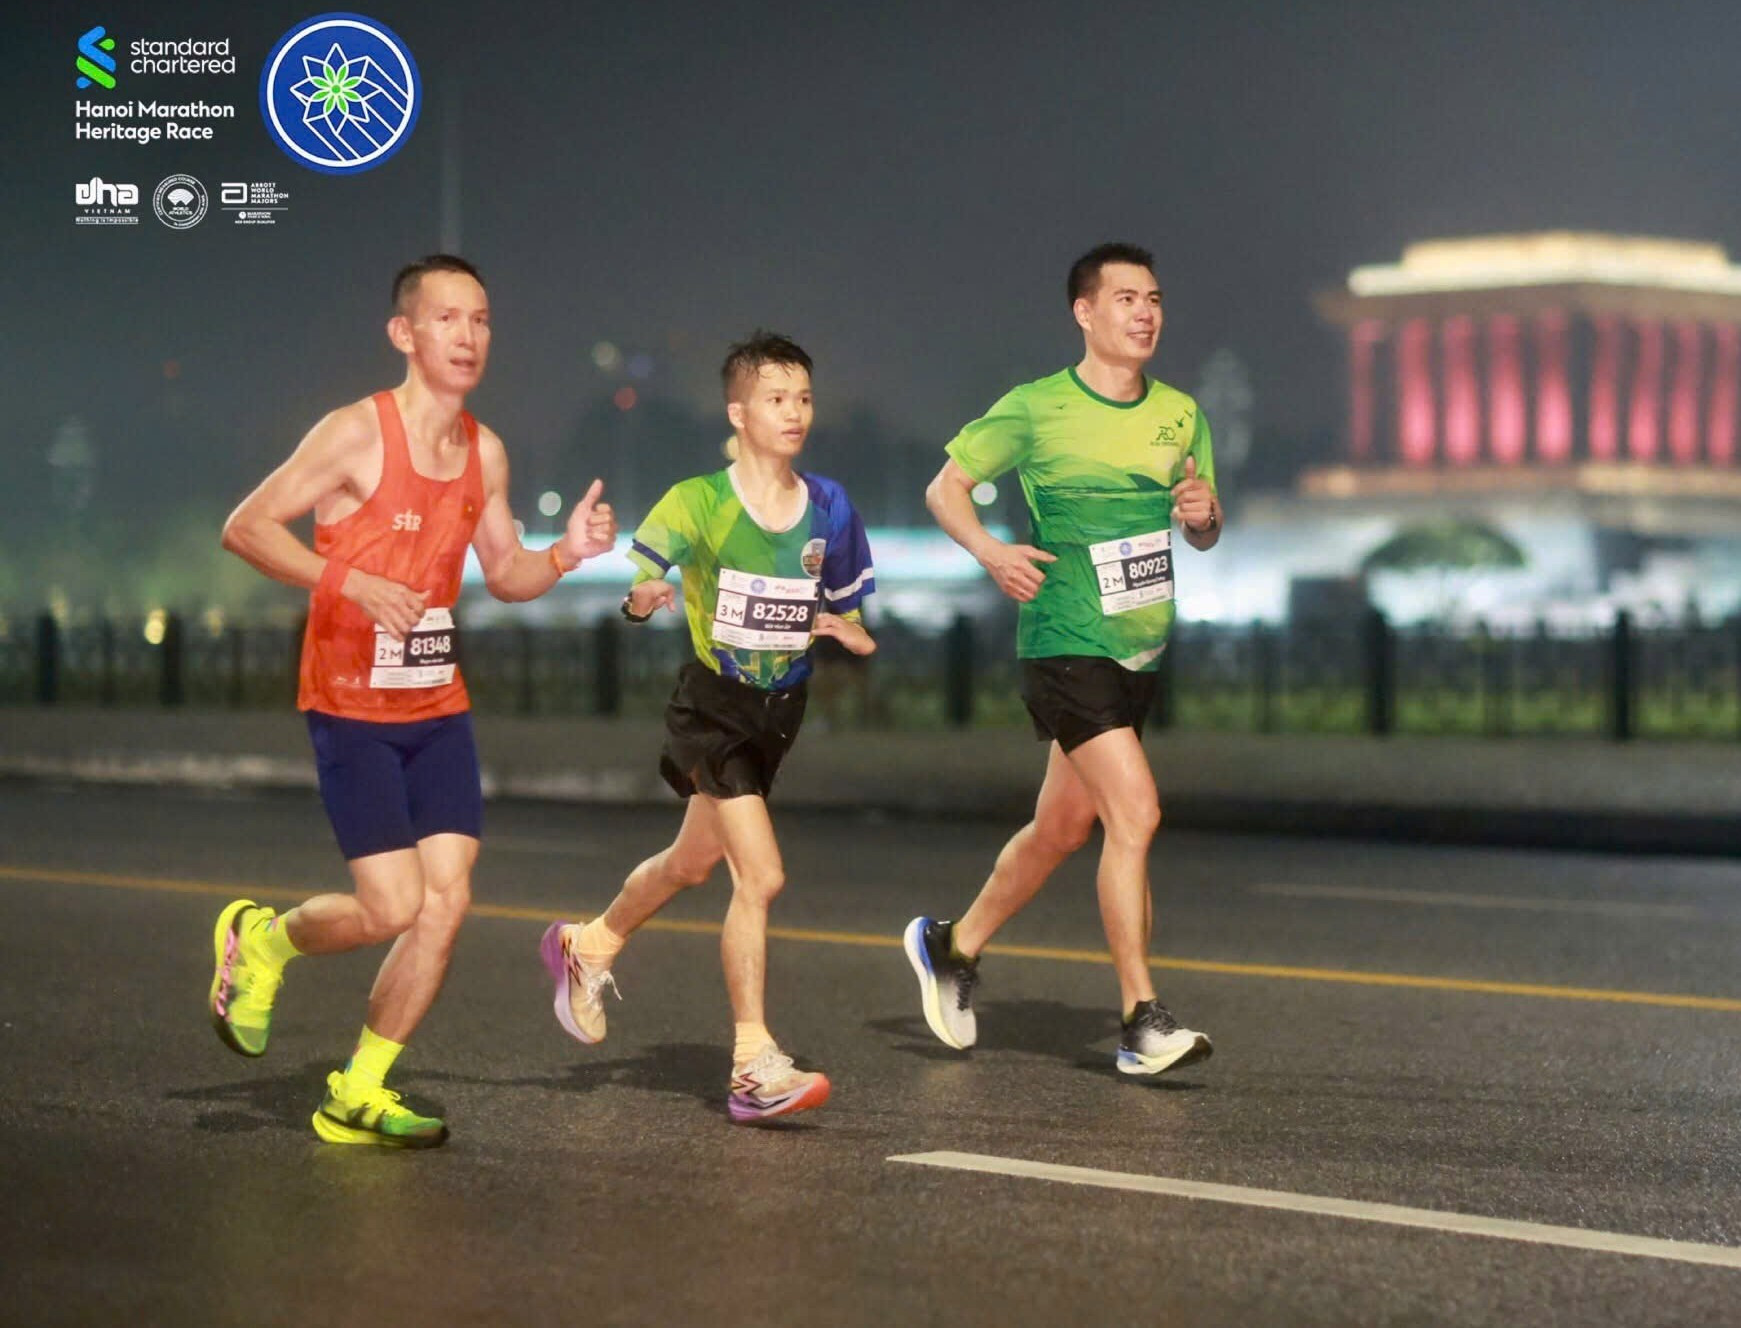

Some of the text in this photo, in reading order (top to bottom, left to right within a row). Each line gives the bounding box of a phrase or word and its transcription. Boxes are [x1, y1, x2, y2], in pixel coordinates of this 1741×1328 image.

[1128, 556, 1168, 579] 80923
[752, 603, 809, 622] 82528
[410, 635, 451, 656] 81348
